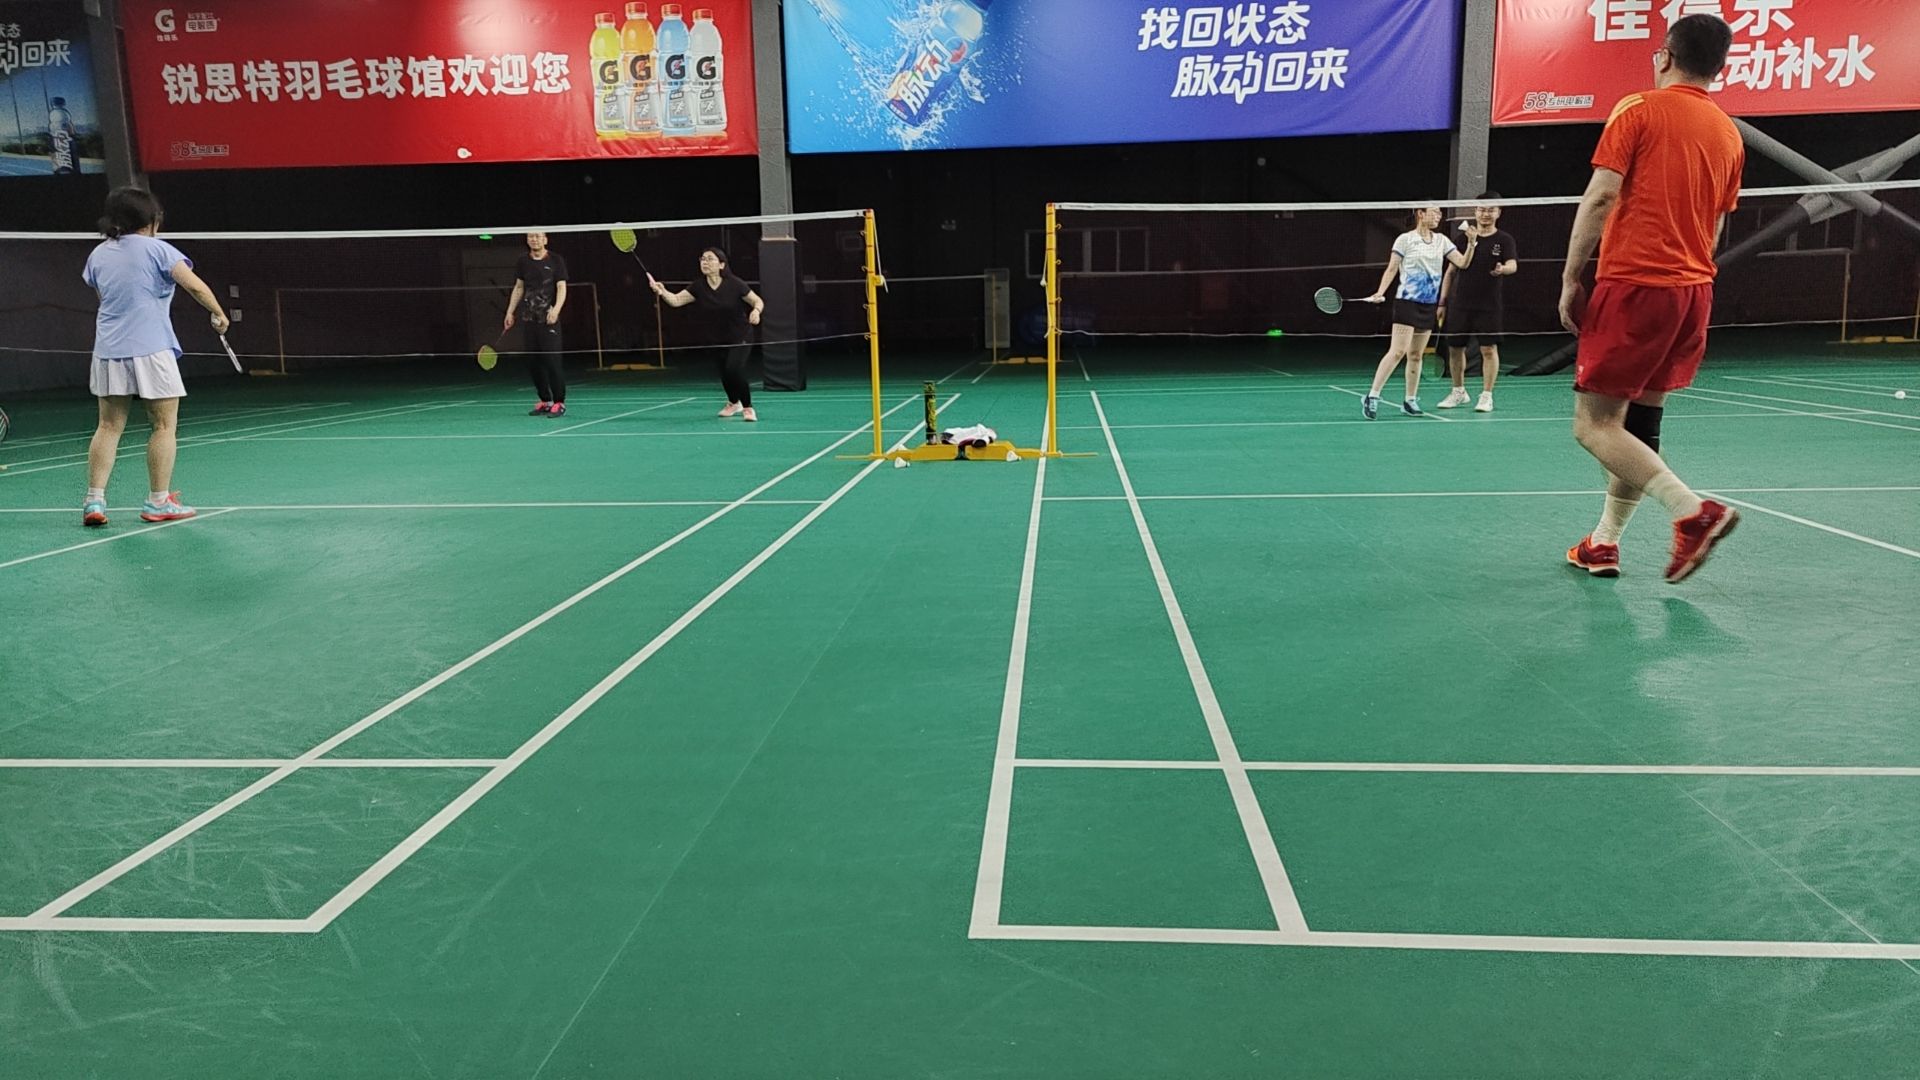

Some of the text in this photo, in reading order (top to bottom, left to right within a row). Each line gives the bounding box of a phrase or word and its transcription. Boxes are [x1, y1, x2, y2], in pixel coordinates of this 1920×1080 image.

[155, 9, 176, 32] G
[1137, 1, 1310, 50] 找回状态
[599, 60, 619, 84] G
[630, 54, 651, 80] G
[665, 54, 686, 80] G
[696, 56, 717, 80] G
[1170, 47, 1350, 104] 脉动回来
[1709, 35, 1876, 92] 动补水
[161, 52, 571, 104] 锐思特羽毛球馆欢迎您
